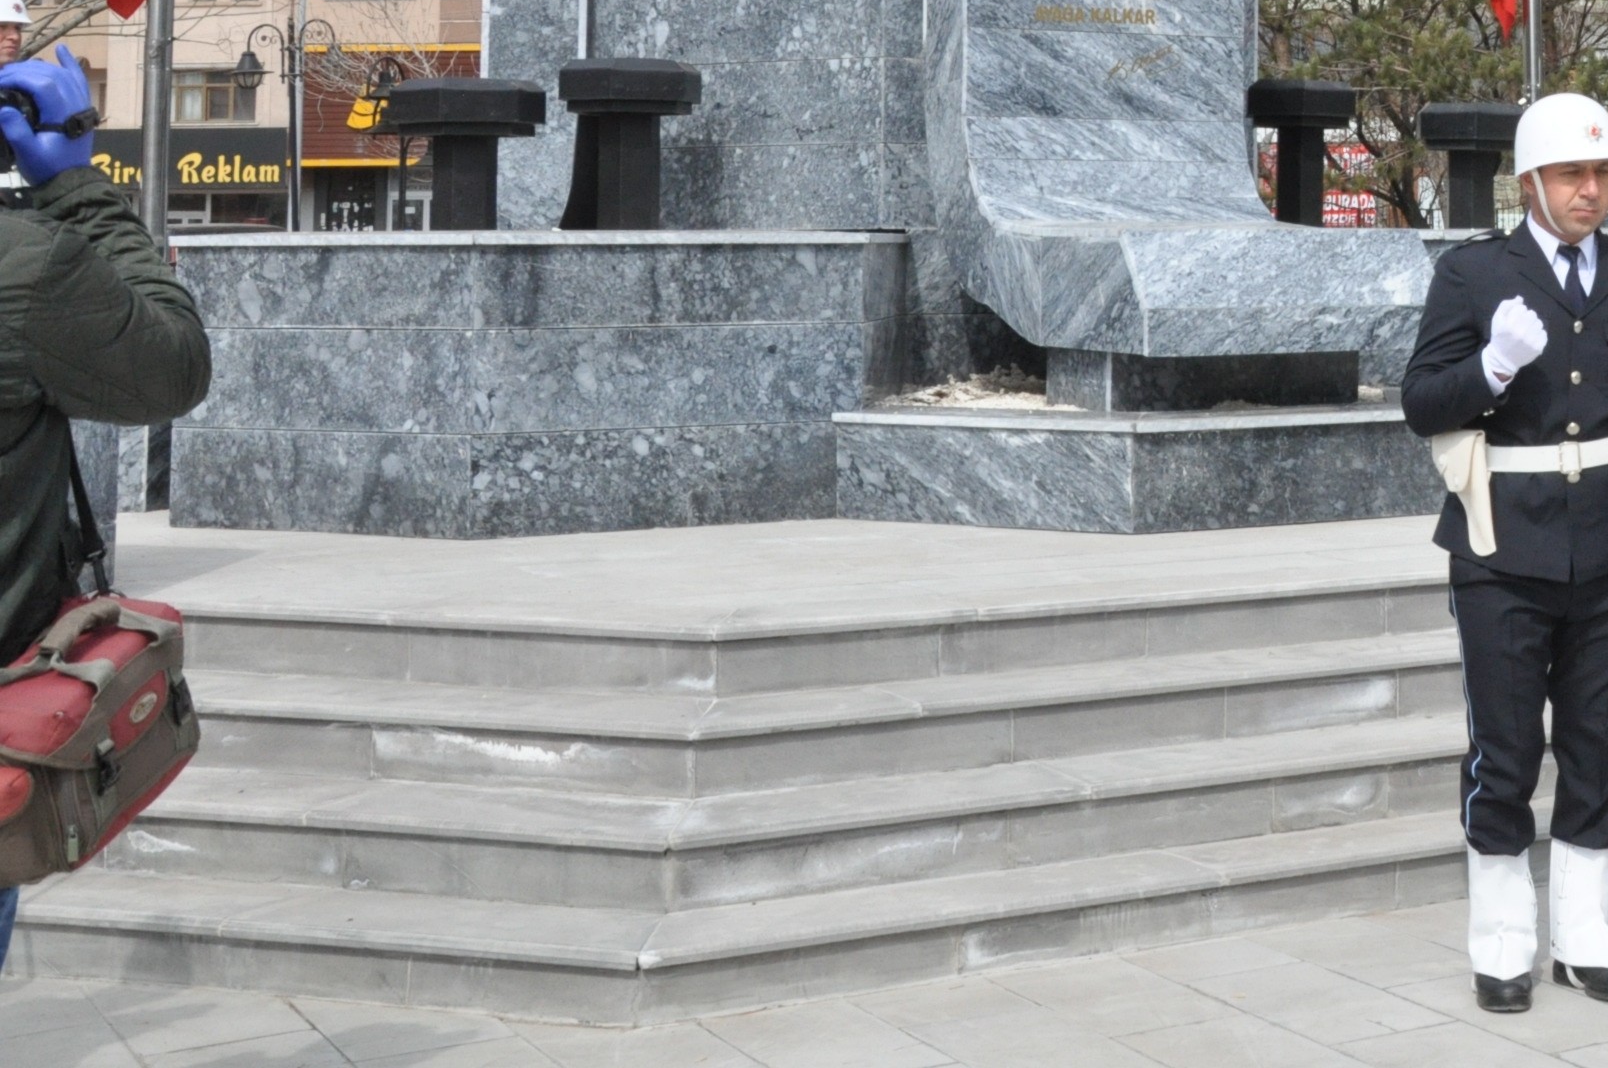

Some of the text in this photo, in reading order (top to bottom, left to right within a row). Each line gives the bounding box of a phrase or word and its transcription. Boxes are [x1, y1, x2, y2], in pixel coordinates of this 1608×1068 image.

[1090, 6, 1156, 25] KALKAR
[177, 152, 280, 184] Reklam
[1322, 194, 1377, 210] BURADA
